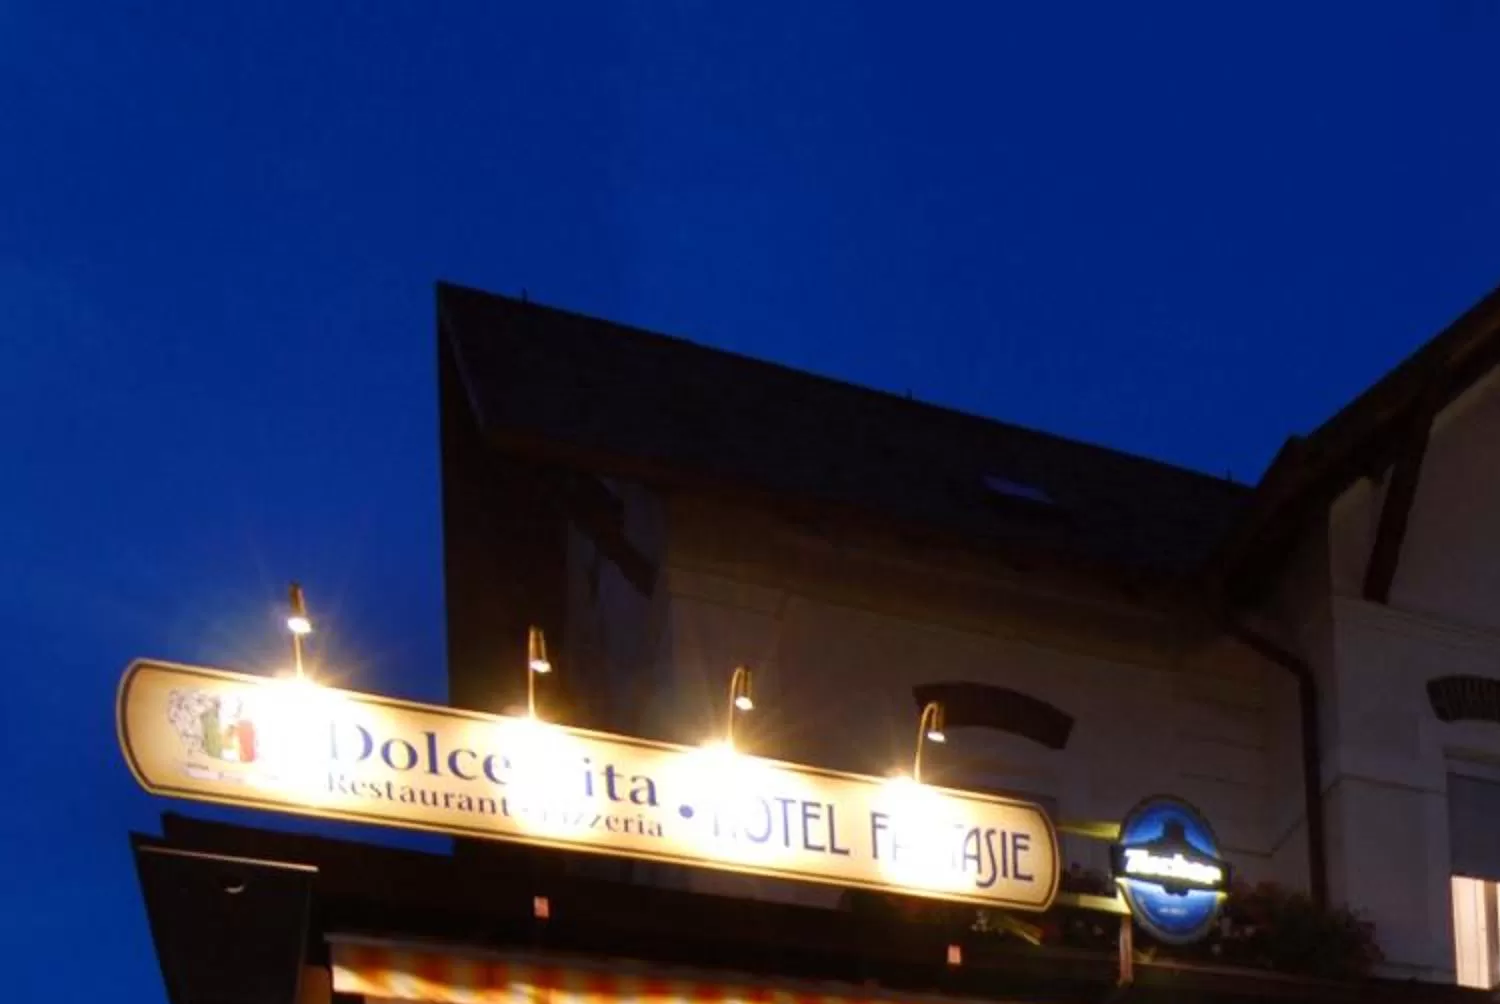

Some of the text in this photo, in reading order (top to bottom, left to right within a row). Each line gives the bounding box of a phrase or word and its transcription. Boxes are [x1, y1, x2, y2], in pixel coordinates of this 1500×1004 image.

[326, 771, 512, 817] Restaurant
[328, 719, 660, 808] Dolce ita
